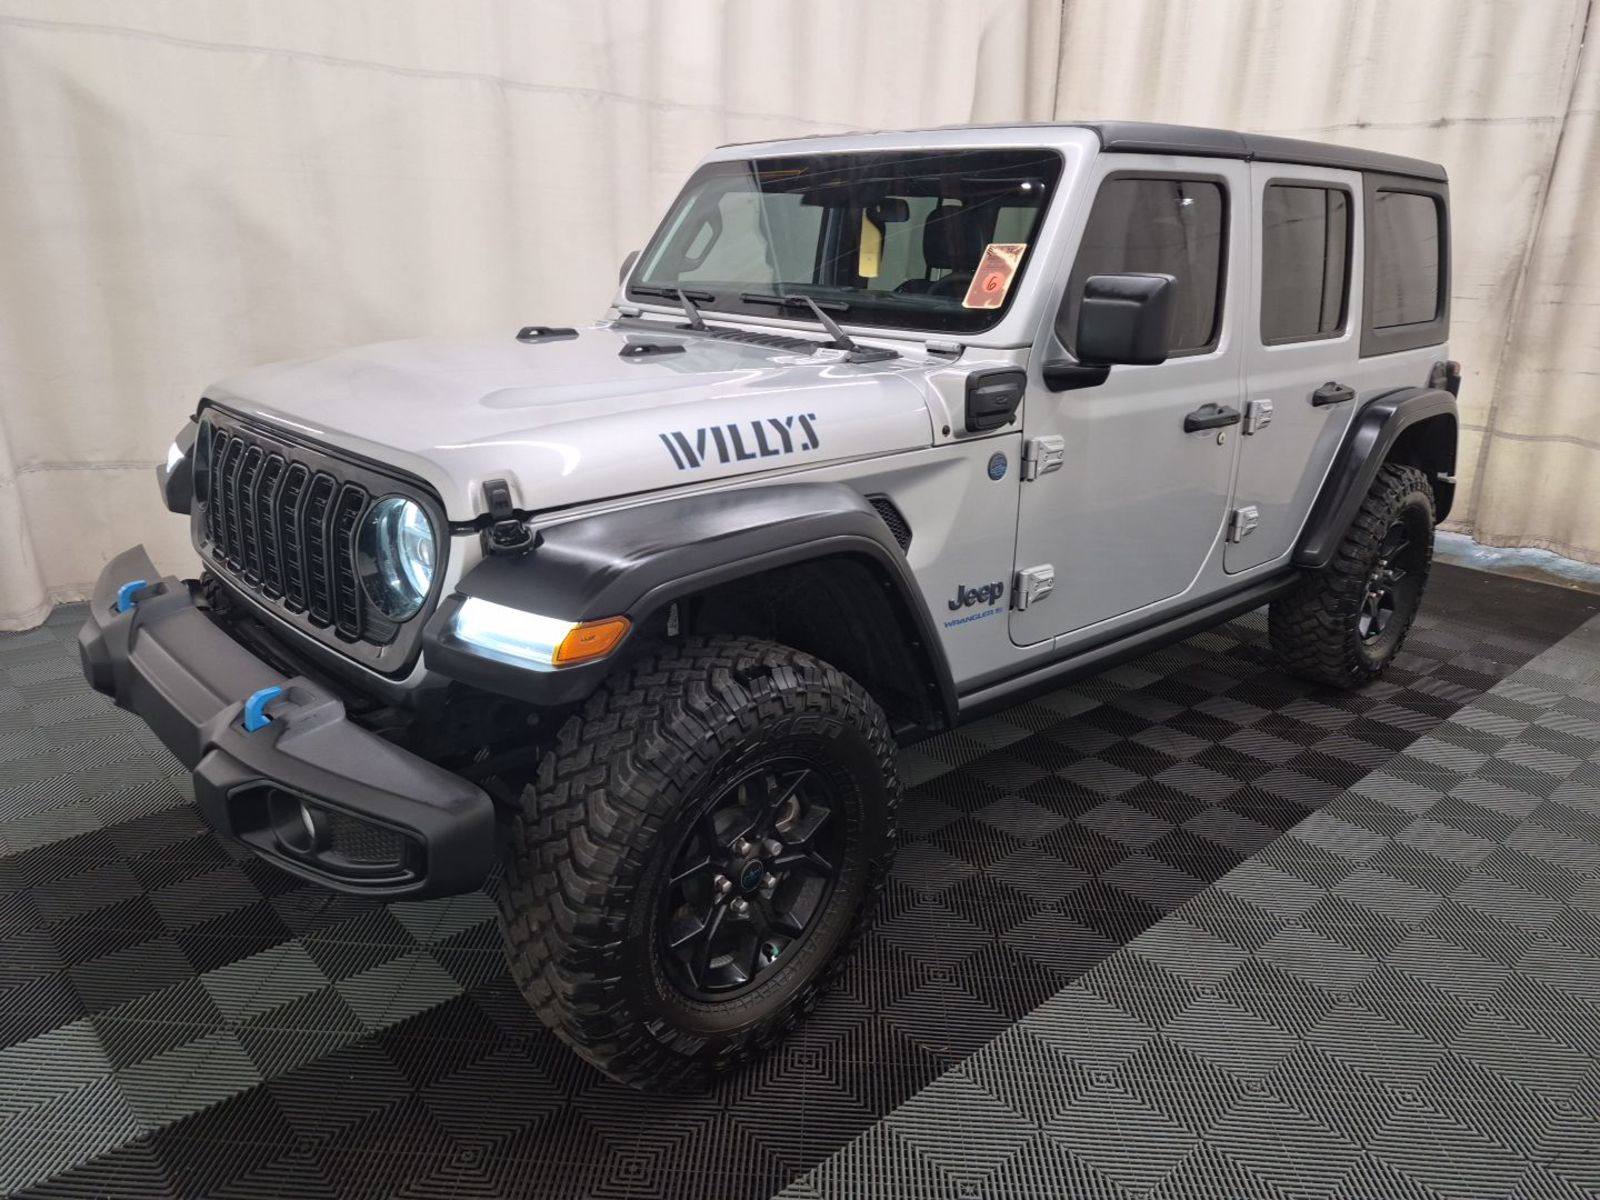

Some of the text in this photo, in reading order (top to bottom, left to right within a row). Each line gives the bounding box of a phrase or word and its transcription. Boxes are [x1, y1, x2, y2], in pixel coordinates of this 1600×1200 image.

[986, 276, 998, 291] 6
[659, 413, 819, 470] WILLYS
[948, 581, 1004, 611] Jeep
[943, 609, 993, 628] WRANGLER
